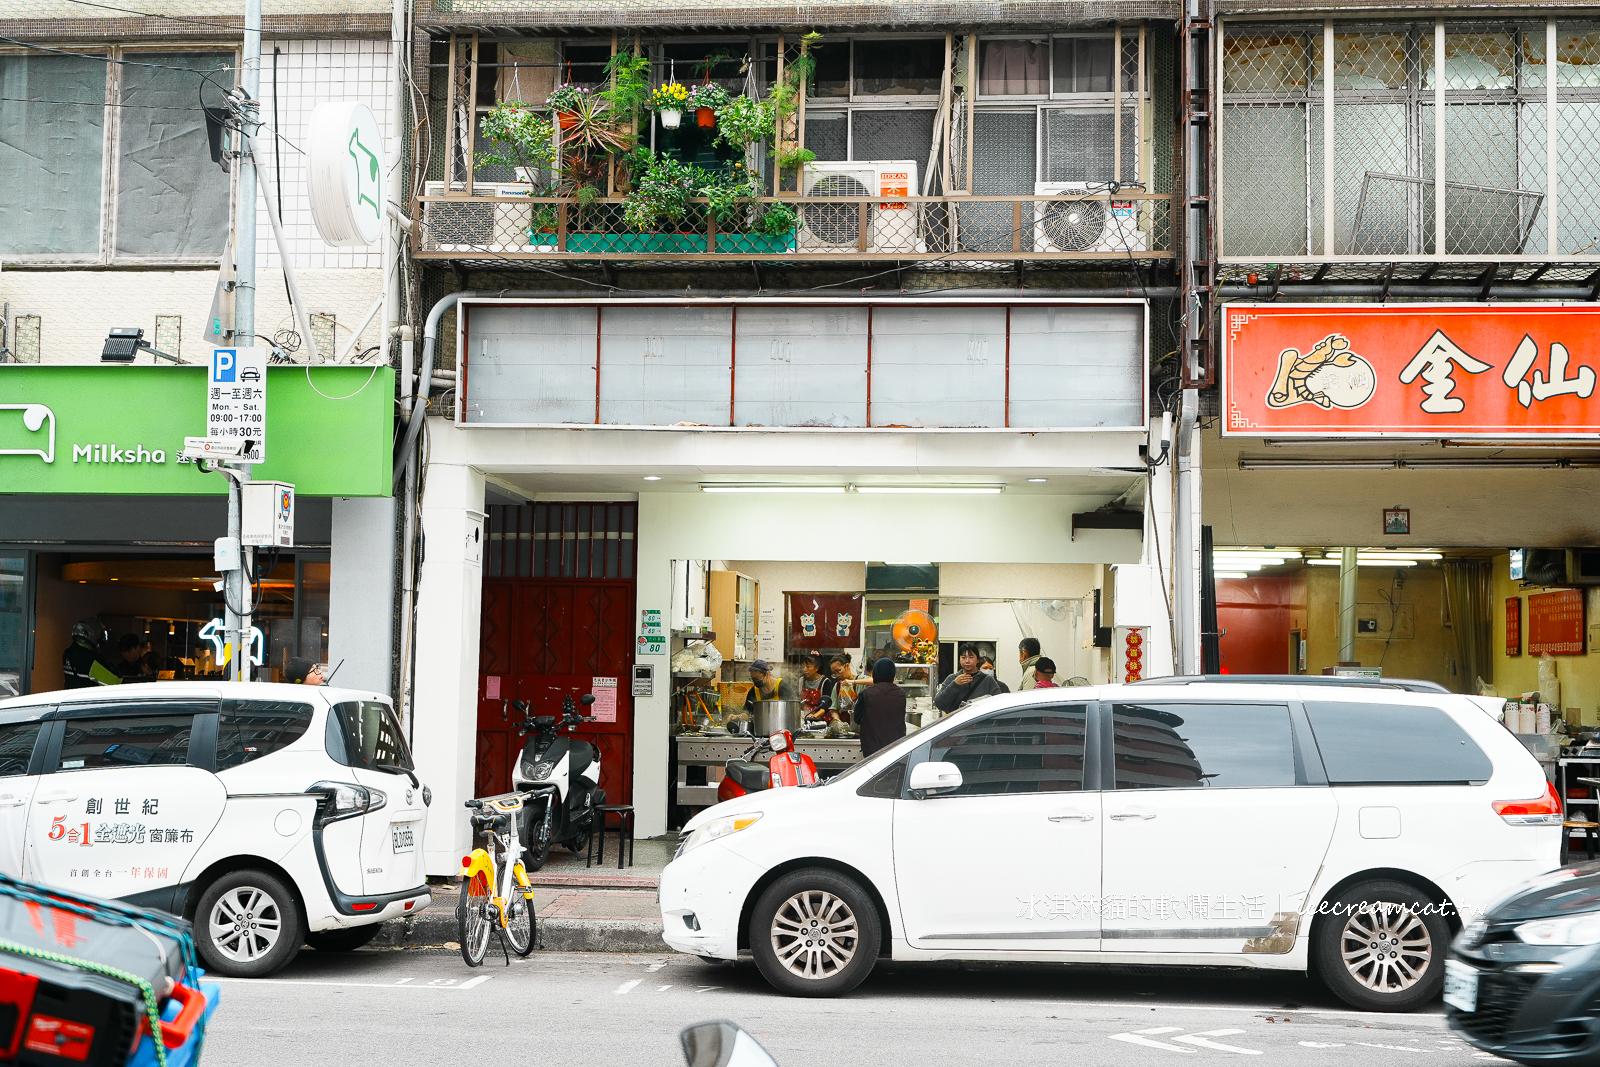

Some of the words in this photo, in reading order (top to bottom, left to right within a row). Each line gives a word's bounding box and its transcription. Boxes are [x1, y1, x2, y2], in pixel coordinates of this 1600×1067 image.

[216, 352, 234, 380] P
[1398, 328, 1598, 414] 金仙
[210, 387, 263, 400] 週一至週六
[212, 403, 231, 411] Mon.
[243, 403, 260, 411] Sat.
[210, 413, 262, 423] 09:00-17:00
[210, 427, 262, 437] 每小時30元
[73, 443, 166, 464] Milksha
[649, 643, 661, 653] 80
[85, 797, 159, 816] 創世紀
